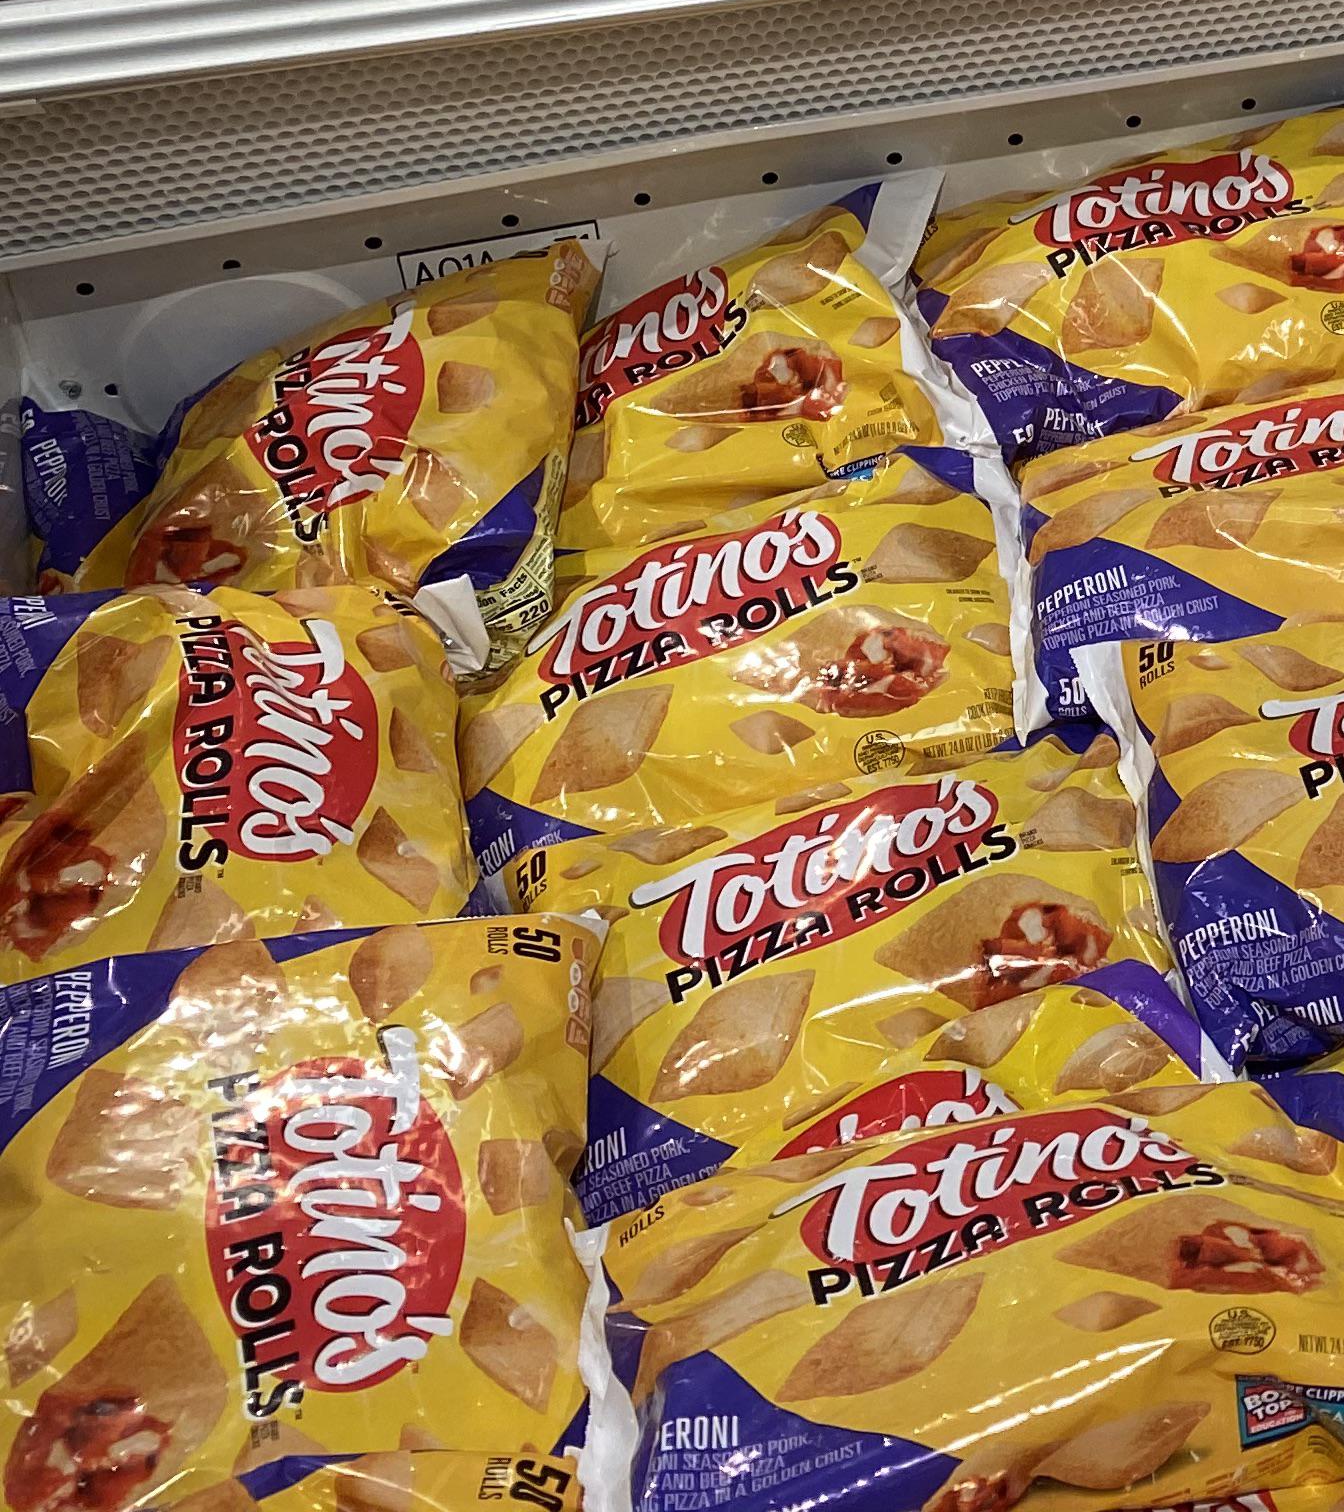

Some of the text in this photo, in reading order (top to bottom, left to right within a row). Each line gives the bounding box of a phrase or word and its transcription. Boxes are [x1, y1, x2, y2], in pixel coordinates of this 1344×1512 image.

[1008, 149, 1292, 245] Totino's
[1046, 196, 1313, 280] PIZZA ROLLS
[623, 303, 748, 388] ROLLS
[499, 571, 530, 601] Facts
[527, 508, 840, 675] Totino's
[1036, 564, 1129, 621] PEPPERONI
[1092, 582, 1147, 608] SEASONED
[518, 599, 550, 627] 220
[1088, 623, 1119, 641] PIZZA
[1185, 595, 1220, 616] CRUST
[540, 559, 861, 722] PIZZA ROLLS
[1138, 640, 1175, 674] 50
[1058, 677, 1086, 706] 50
[1138, 660, 1176, 690] ROLLS
[178, 714, 234, 873] ROLLS
[630, 776, 993, 959] Totino's
[666, 824, 1020, 1007] PIZZA ROLLS
[1178, 907, 1280, 968] PEPPERONI
[486, 926, 509, 956] ROLLS
[512, 926, 562, 964] 50
[1240, 934, 1299, 960] SEASONED
[1256, 946, 1313, 975] BEEF PIZZA
[1290, 957, 1334, 984] GOLDEN
[588, 1151, 650, 1189] SEASONED
[604, 1162, 673, 1201] BEEF PIZZA
[768, 1115, 1197, 1262] Totino's
[282, 1024, 454, 1387] Totino's
[808, 1162, 1227, 1307] PIZZA ROLLS
[225, 1232, 305, 1422] ROLLS
[1298, 1334, 1314, 1353] NET
[750, 1439, 864, 1493] GOLDEN CRUST
